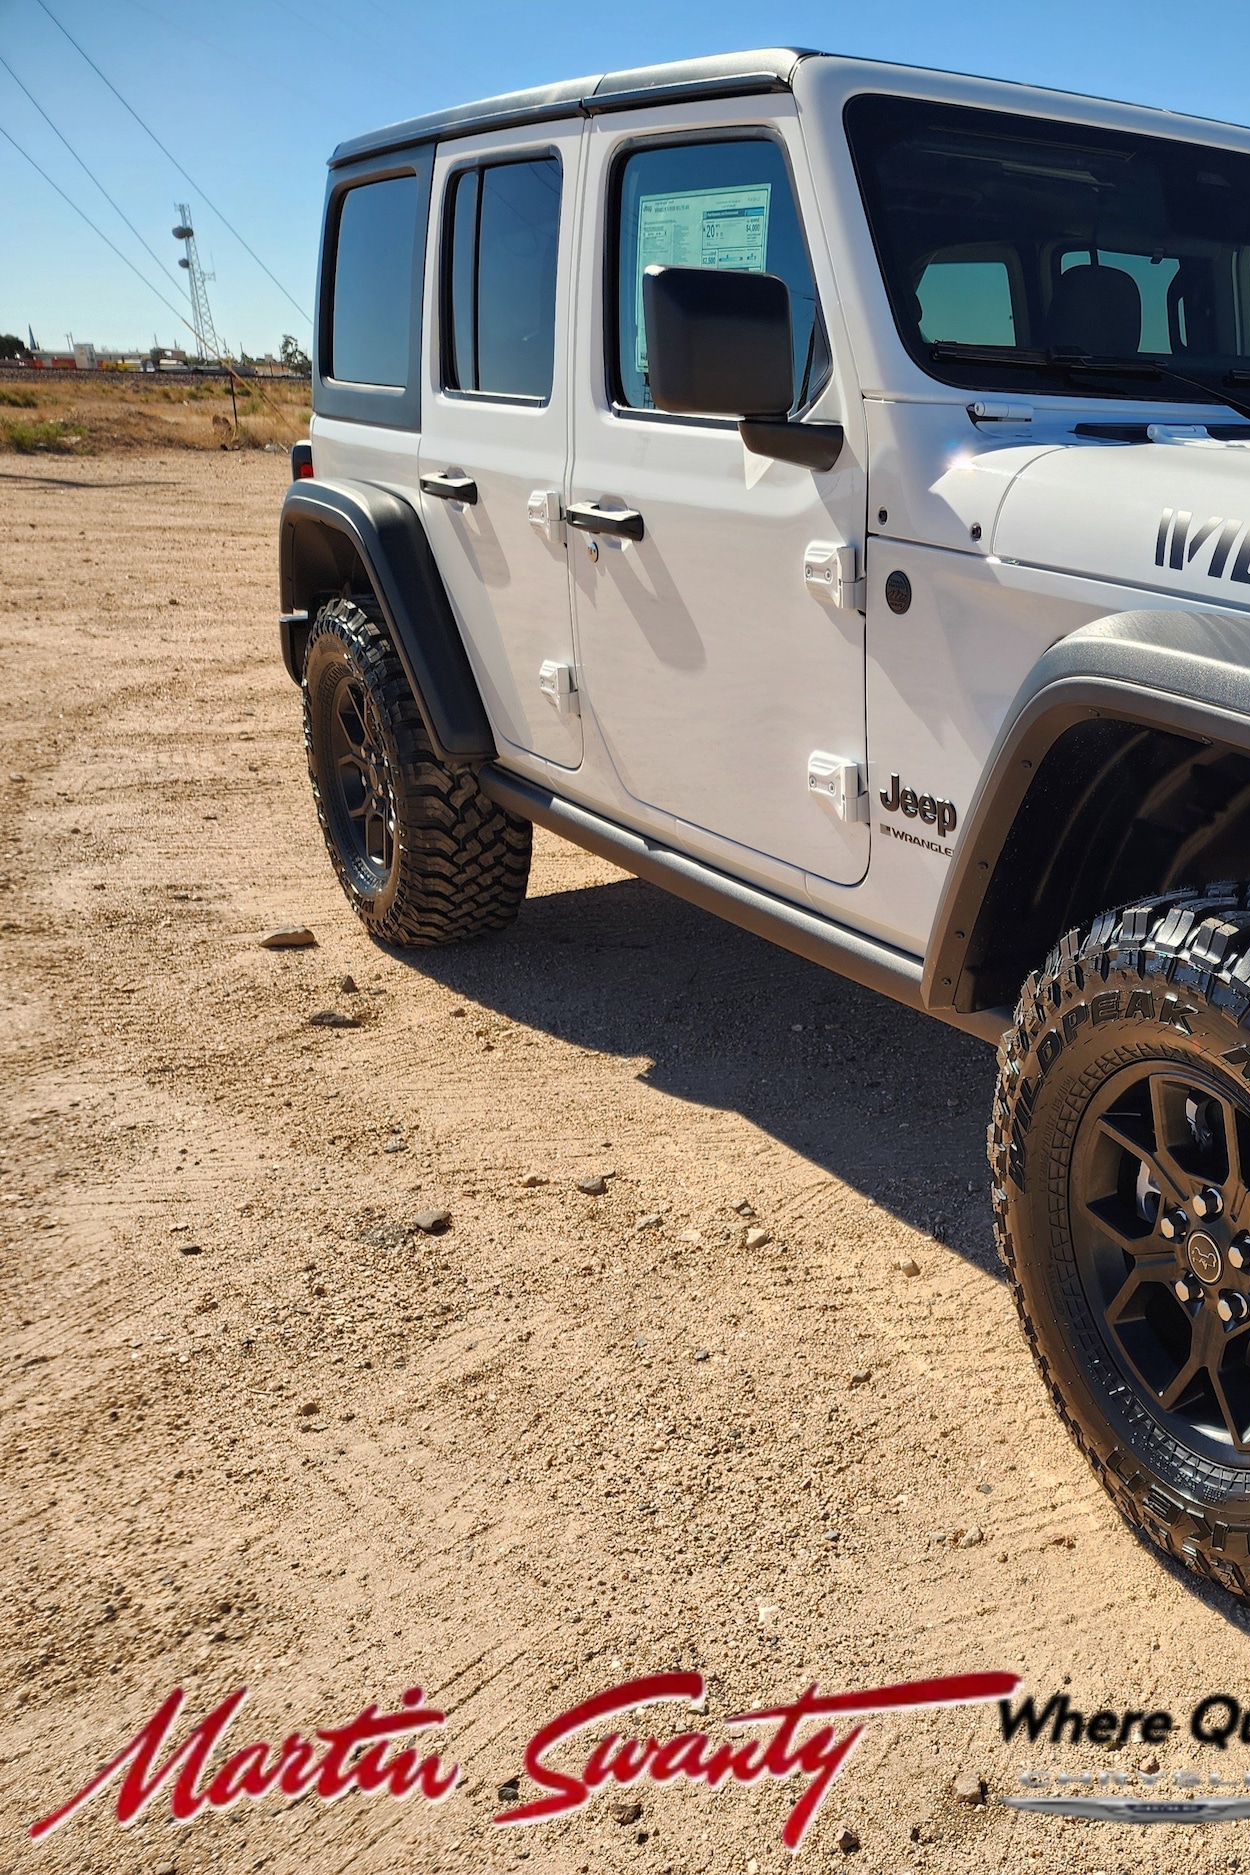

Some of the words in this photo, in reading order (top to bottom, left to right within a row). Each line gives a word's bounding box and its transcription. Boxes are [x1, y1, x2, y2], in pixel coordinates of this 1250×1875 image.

[880, 772, 957, 838] Jeep
[892, 827, 955, 858] WRANGLE
[1008, 988, 1199, 1194] WILDPEAK
